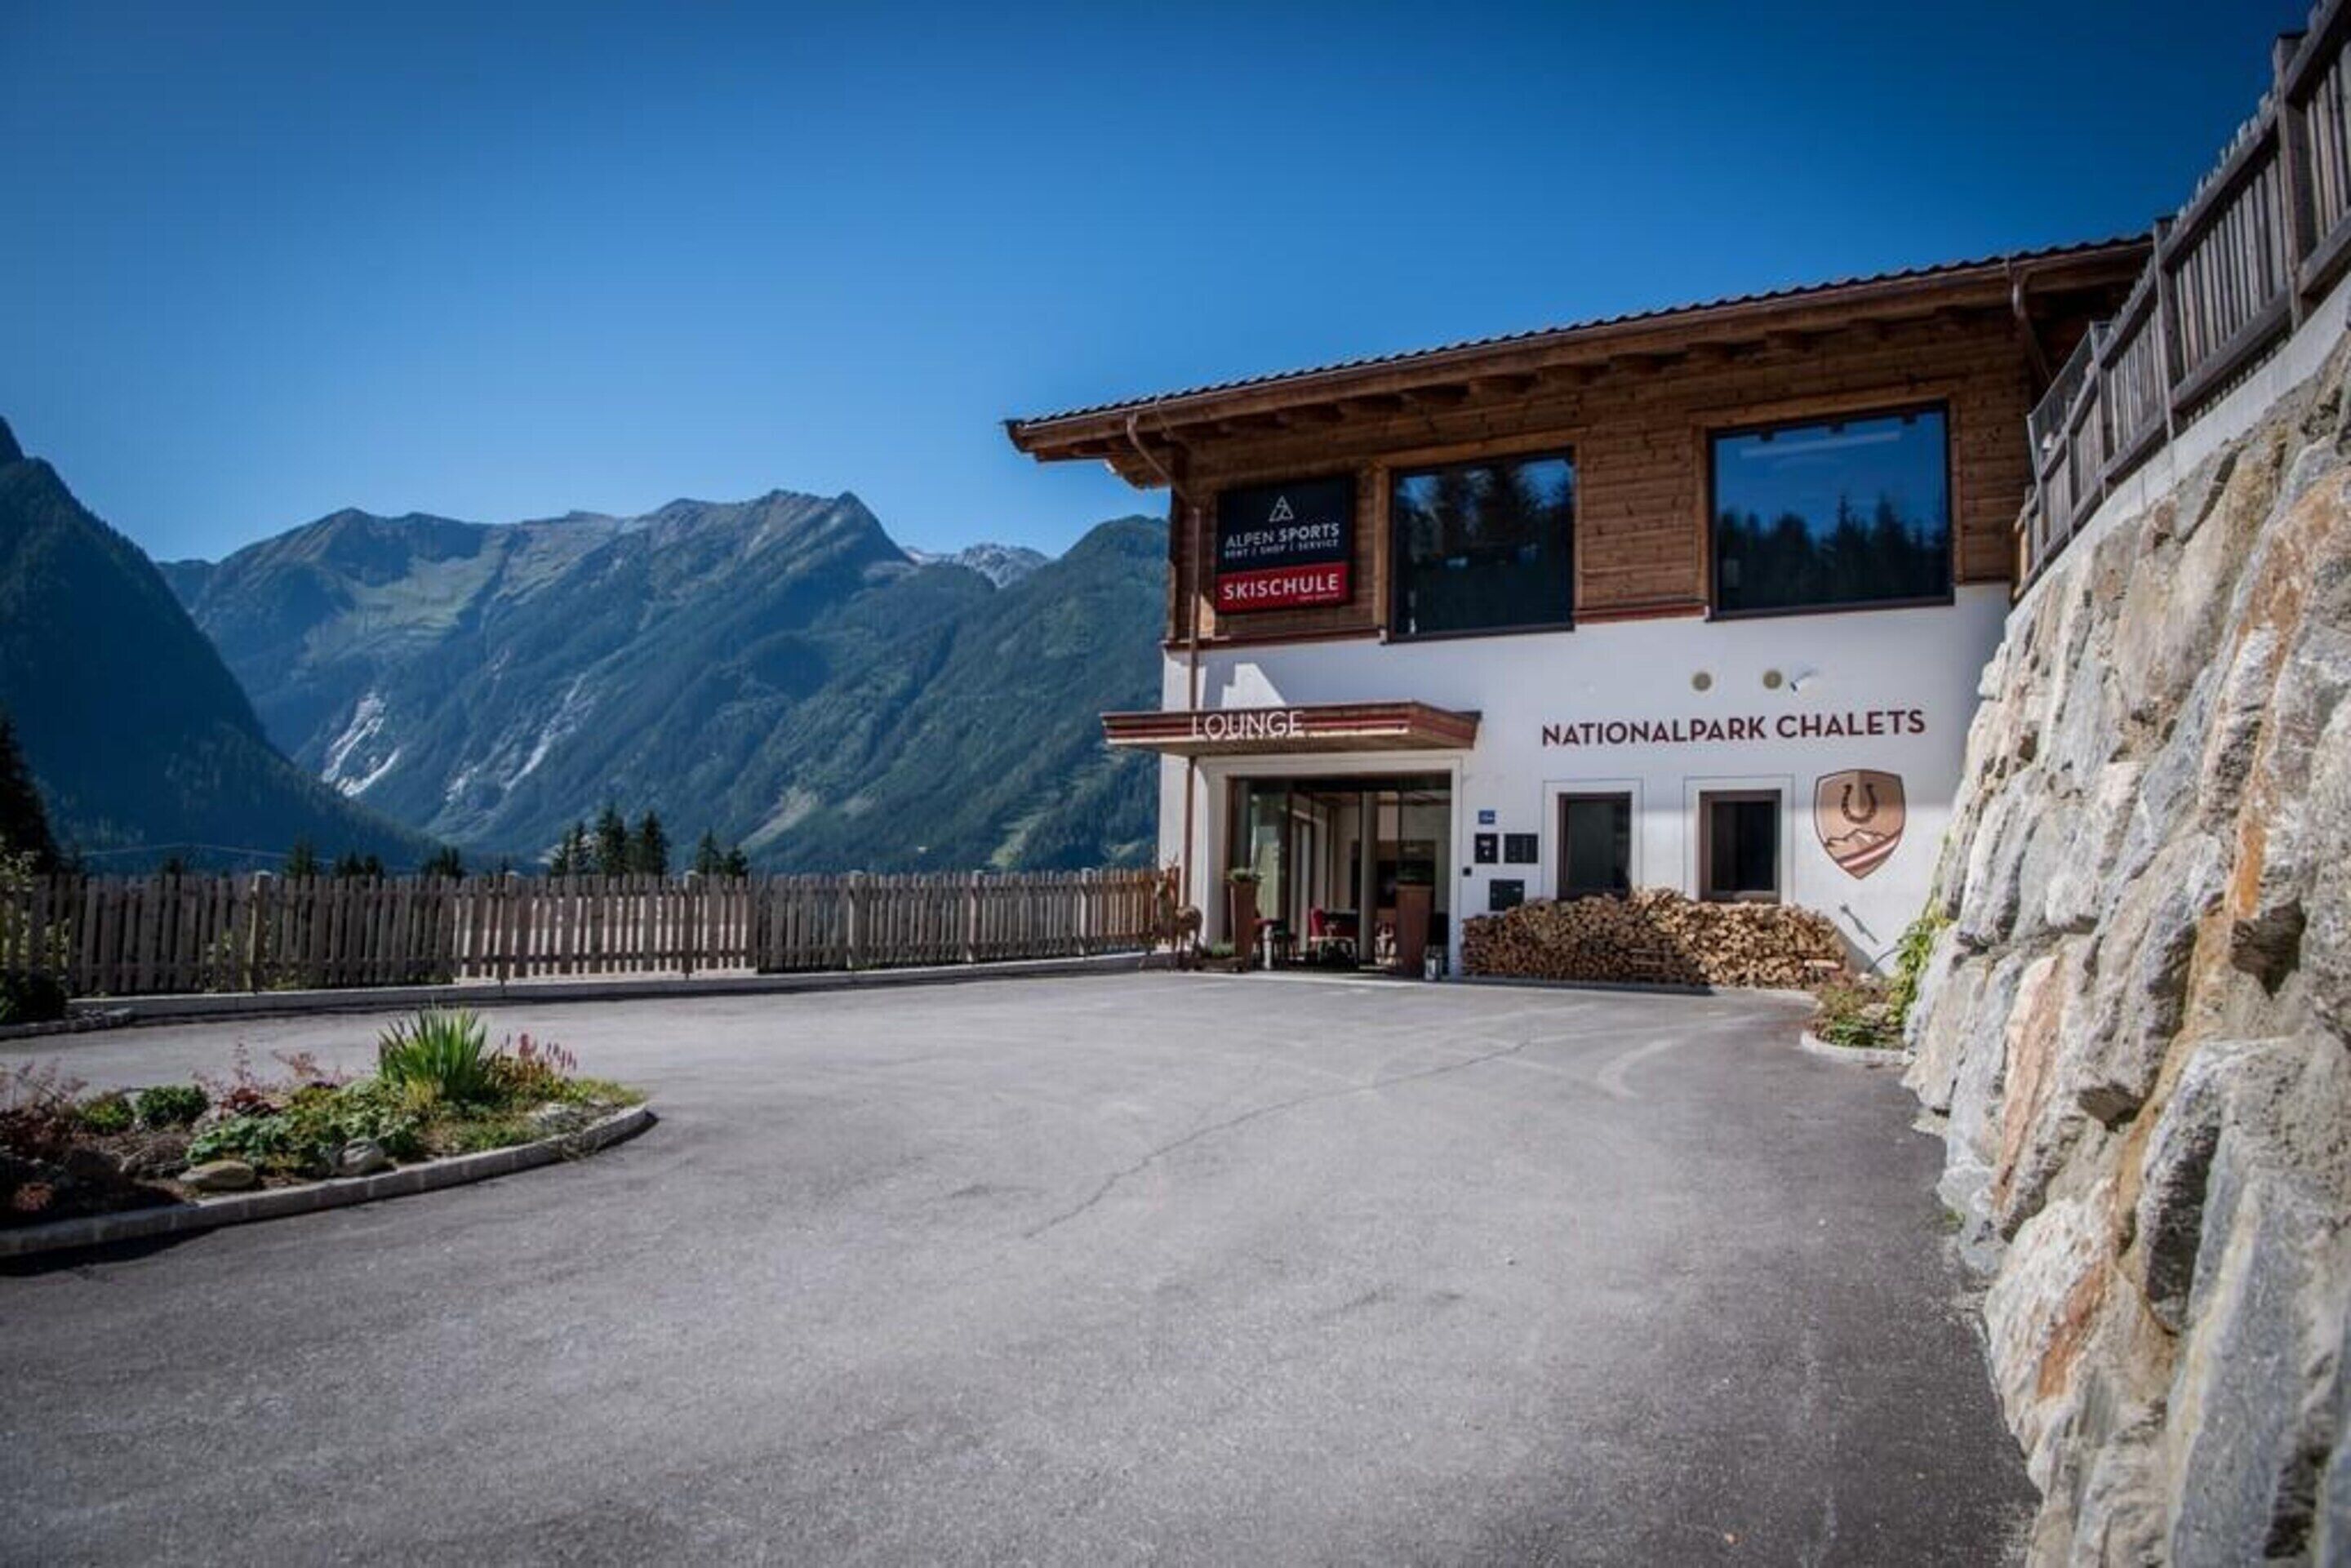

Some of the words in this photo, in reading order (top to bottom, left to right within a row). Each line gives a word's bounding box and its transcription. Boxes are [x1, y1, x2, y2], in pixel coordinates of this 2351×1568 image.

[1225, 531, 1275, 549] ALPEN
[1278, 523, 1340, 544] SPORTS
[1224, 573, 1340, 601] SKISCHULE
[1192, 711, 1306, 740] LOUNGE
[1541, 716, 1767, 747] NATIONALPARK
[1775, 709, 1927, 739] CHALETS
